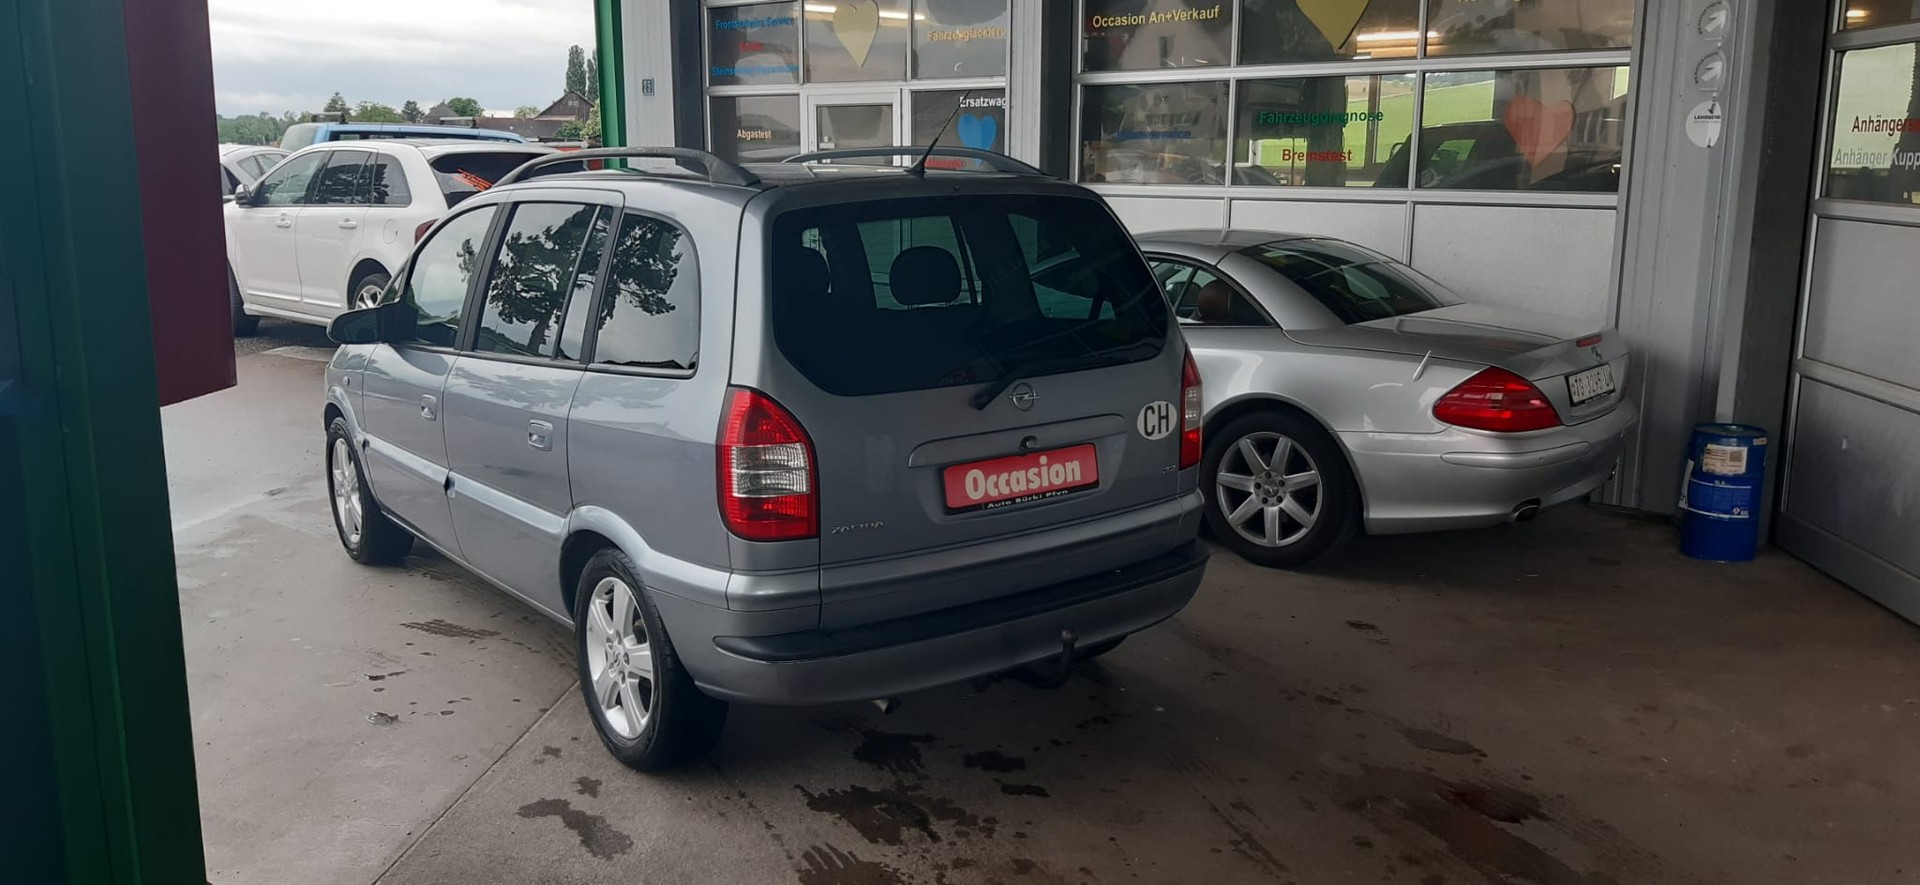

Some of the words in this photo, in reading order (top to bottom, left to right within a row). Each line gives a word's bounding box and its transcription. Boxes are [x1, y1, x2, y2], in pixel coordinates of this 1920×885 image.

[1093, 13, 1145, 28] Occasion
[1149, 5, 1220, 24] An+Verkauf
[1260, 111, 1384, 127] Fahrzeugdiagnose
[737, 129, 771, 140] Abgastest
[1281, 149, 1352, 161] Bremstest
[1834, 146, 1888, 168] Anhänger
[1144, 403, 1169, 437] CH
[965, 455, 1081, 500] Occasion
[987, 499, 1011, 508] Auto
